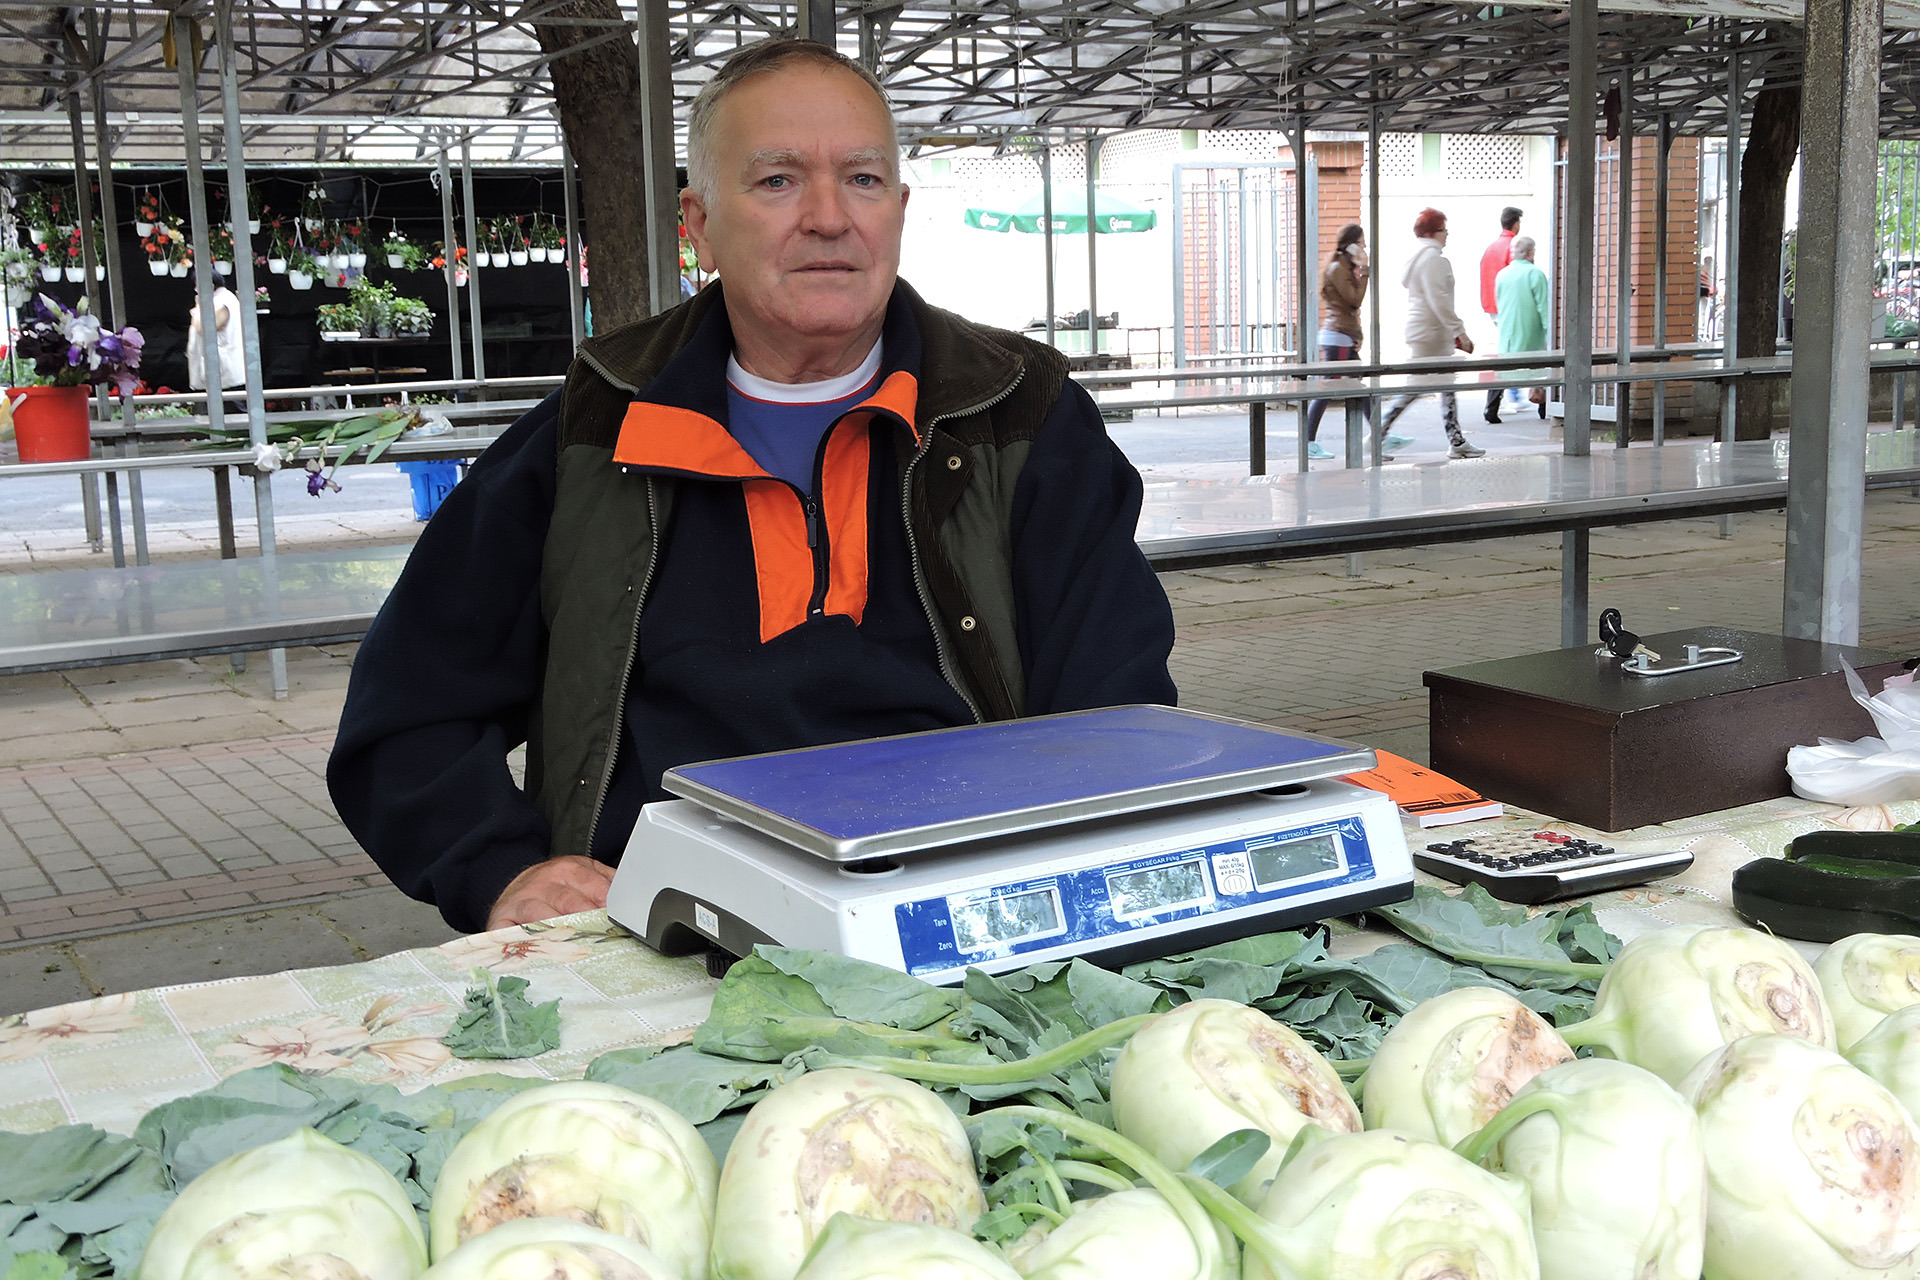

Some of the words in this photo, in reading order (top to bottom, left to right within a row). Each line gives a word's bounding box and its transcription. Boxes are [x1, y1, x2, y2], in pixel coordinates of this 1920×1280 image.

[1090, 888, 1104, 896] Accu
[933, 918, 947, 928] Tare
[938, 942, 953, 951] Zero
